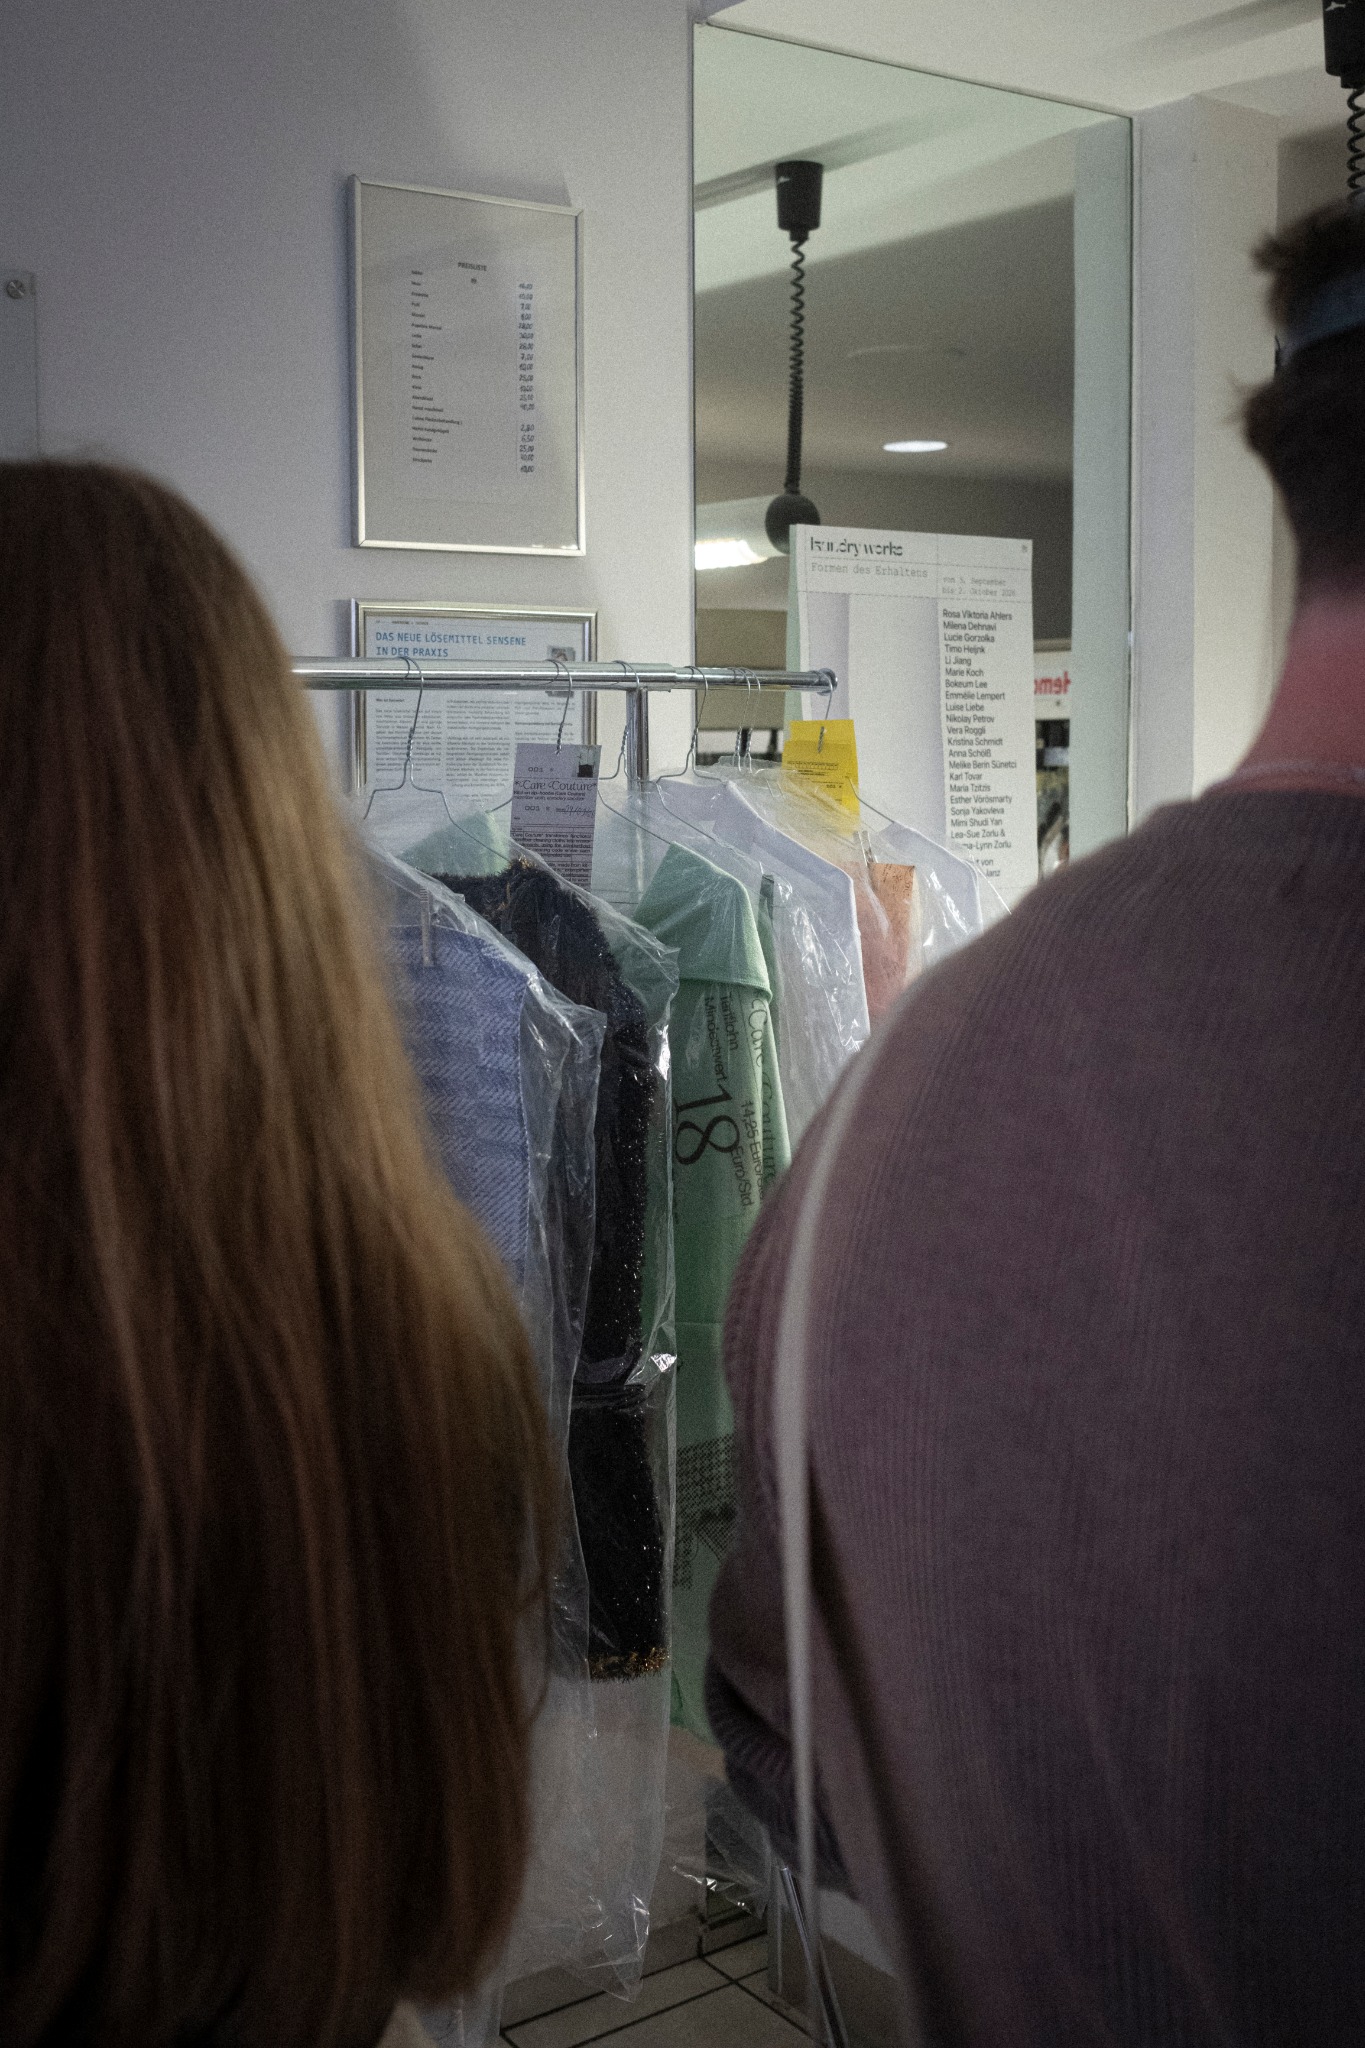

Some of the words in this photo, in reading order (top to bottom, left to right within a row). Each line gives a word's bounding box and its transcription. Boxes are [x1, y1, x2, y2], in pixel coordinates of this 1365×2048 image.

[811, 562, 848, 574] Formen
[853, 565, 871, 575] des
[875, 566, 928, 578] Erhaltens
[943, 609, 960, 618] Rosa
[962, 610, 988, 619] Viktoria
[990, 611, 1012, 620] Ahlers
[943, 621, 966, 630] Milena
[968, 622, 996, 631] Dehnavi
[375, 632, 394, 641] DAS
[397, 632, 421, 642] NEUE
[425, 632, 483, 645] LÖSEMITTEL
[486, 636, 526, 646] SENSENE
[944, 633, 962, 641] Lucie
[376, 647, 389, 656] IN
[391, 647, 409, 657] DER
[413, 648, 449, 657] PRAXIS
[945, 644, 962, 653] Timo
[945, 656, 951, 664] Li
[953, 657, 971, 666] Jiang
[945, 668, 964, 676] Marie
[966, 668, 984, 677] Koch
[945, 679, 973, 688] Bokeum
[975, 680, 987, 688] Lee
[976, 692, 1005, 702] Lempert
[945, 703, 964, 711] Luise
[966, 703, 984, 711] Liebe
[946, 714, 971, 724] Nikolay
[973, 714, 995, 723] Petrov
[947, 726, 963, 734] Vera
[964, 726, 986, 736] Roggli
[947, 737, 973, 746] Kristina
[975, 737, 1003, 746] Schmidt
[949, 749, 967, 757] Anna
[949, 760, 971, 769] Melike
[973, 760, 990, 769] Berin
[950, 772, 963, 780] Karl
[964, 772, 982, 780] Tovar
[519, 780, 546, 790] Care
[548, 780, 594, 792] Couture
[950, 784, 969, 792] Maria
[950, 795, 972, 804] Esther
[951, 807, 969, 817] Sonja
[971, 806, 1004, 815] Yakovleva
[951, 818, 967, 827] Mimi
[969, 818, 989, 826] Shudi
[990, 818, 1003, 826] Yan
[951, 829, 980, 839] Lea-Sue
[982, 829, 999, 837] Zorlu
[994, 840, 1012, 849] Zorlu
[673, 1084, 740, 1165] 18
